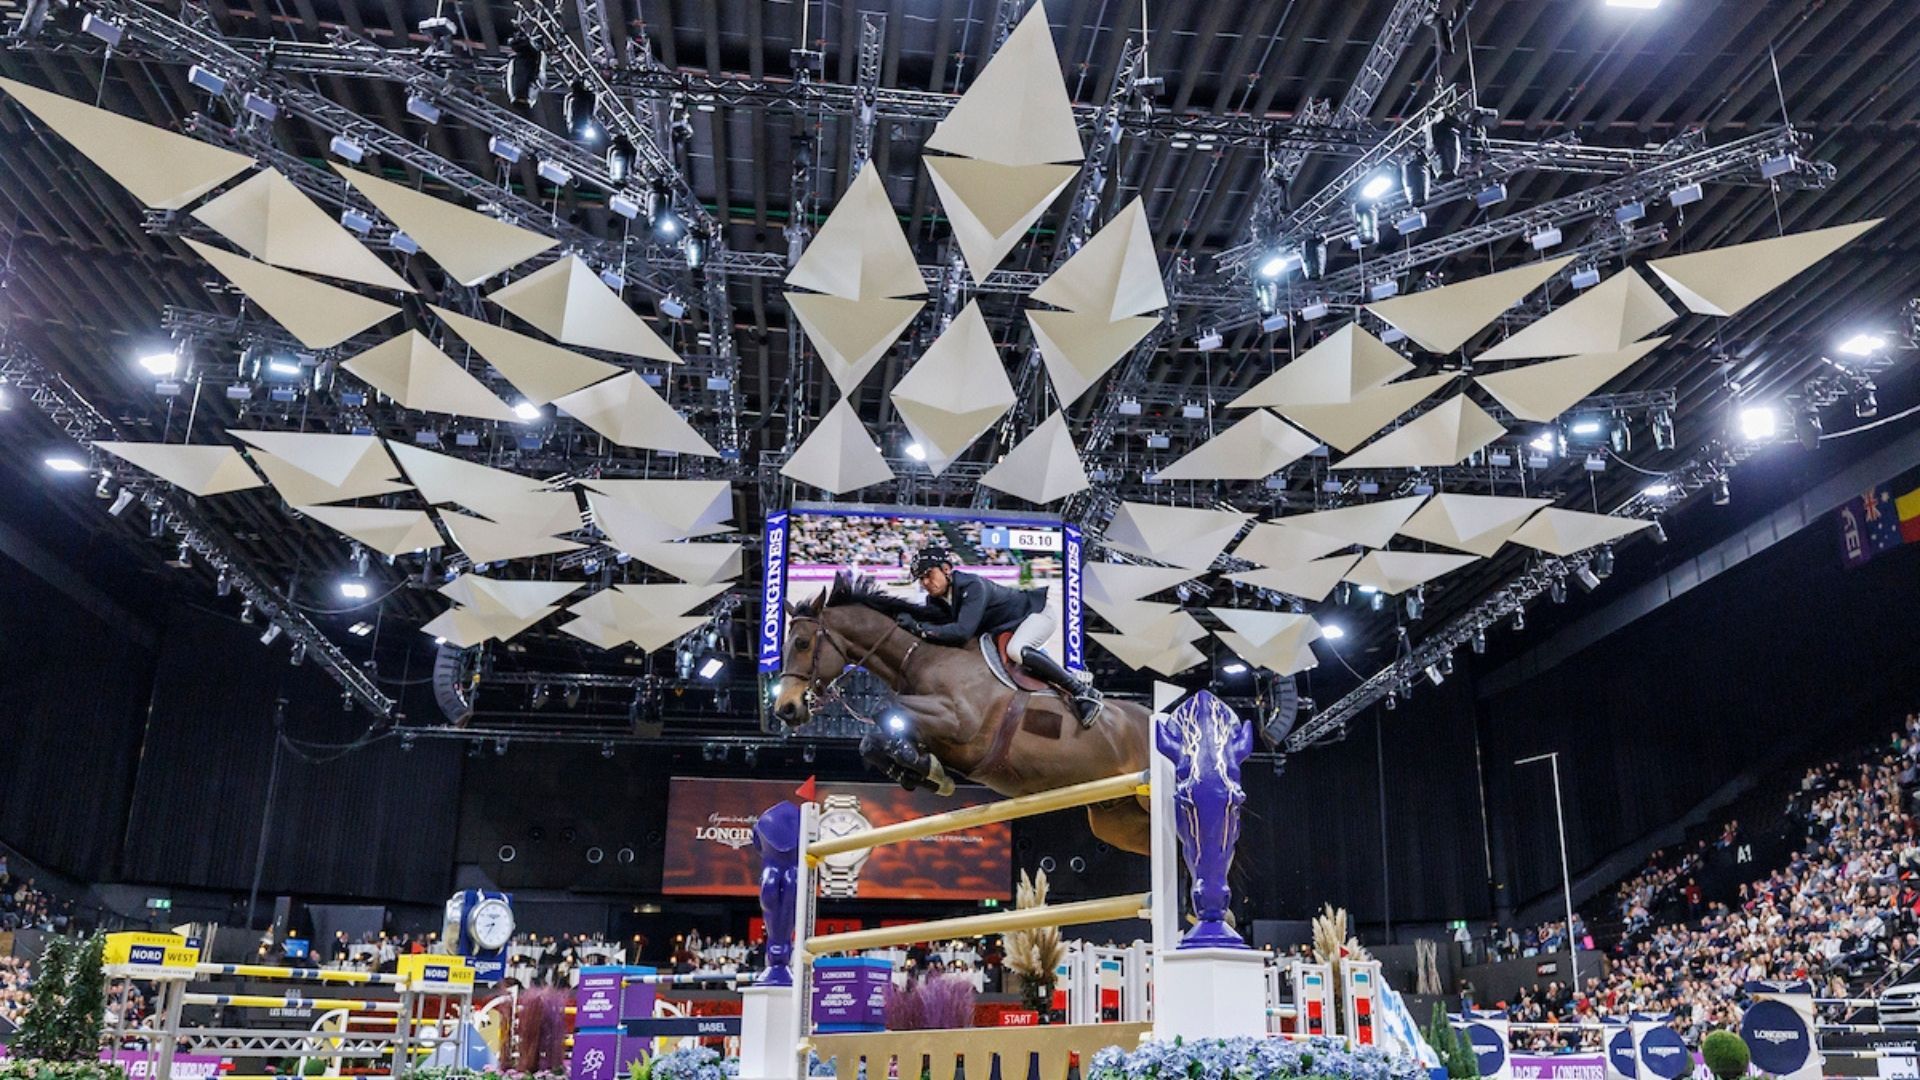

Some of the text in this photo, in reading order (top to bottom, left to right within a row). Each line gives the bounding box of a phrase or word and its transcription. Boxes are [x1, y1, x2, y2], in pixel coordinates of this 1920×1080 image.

[991, 533, 1052, 546] 0 63.10
[763, 528, 784, 655] LONGINES
[1068, 540, 1080, 665] LONGINES
[695, 827, 754, 840] LONGIN
[1737, 843, 1752, 864] A1
[131, 949, 195, 963] NORD WEST
[425, 969, 473, 979] NORD WEST
[822, 971, 856, 979] LONGINES
[585, 978, 614, 987] LONGINES
[1004, 1014, 1033, 1025] START
[698, 1022, 727, 1032] BASEL
[1753, 1029, 1800, 1040] LONGINES
[1647, 1046, 1681, 1054] LONGINES
[1552, 1065, 1604, 1080] LONGINES
